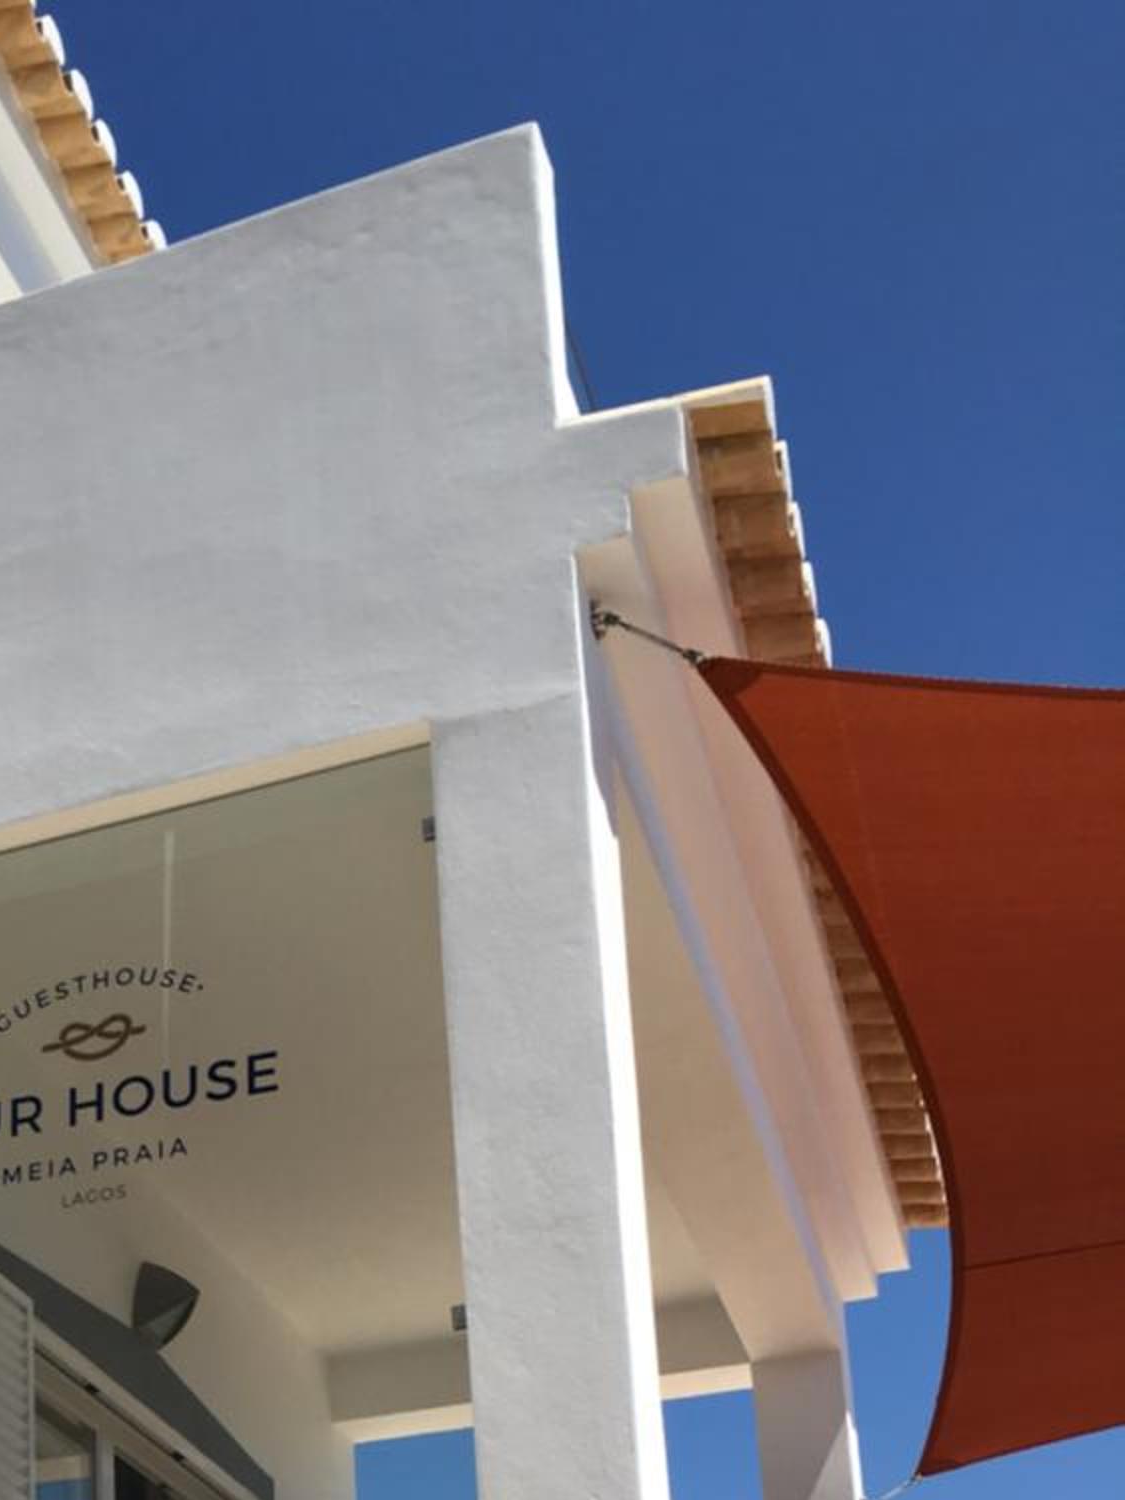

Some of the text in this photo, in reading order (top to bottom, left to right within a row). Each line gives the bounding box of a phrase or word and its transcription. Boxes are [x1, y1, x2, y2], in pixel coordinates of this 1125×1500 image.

[68, 1050, 280, 1127] HOUSE
[1, 1137, 188, 1186] MEIA PRAIA
